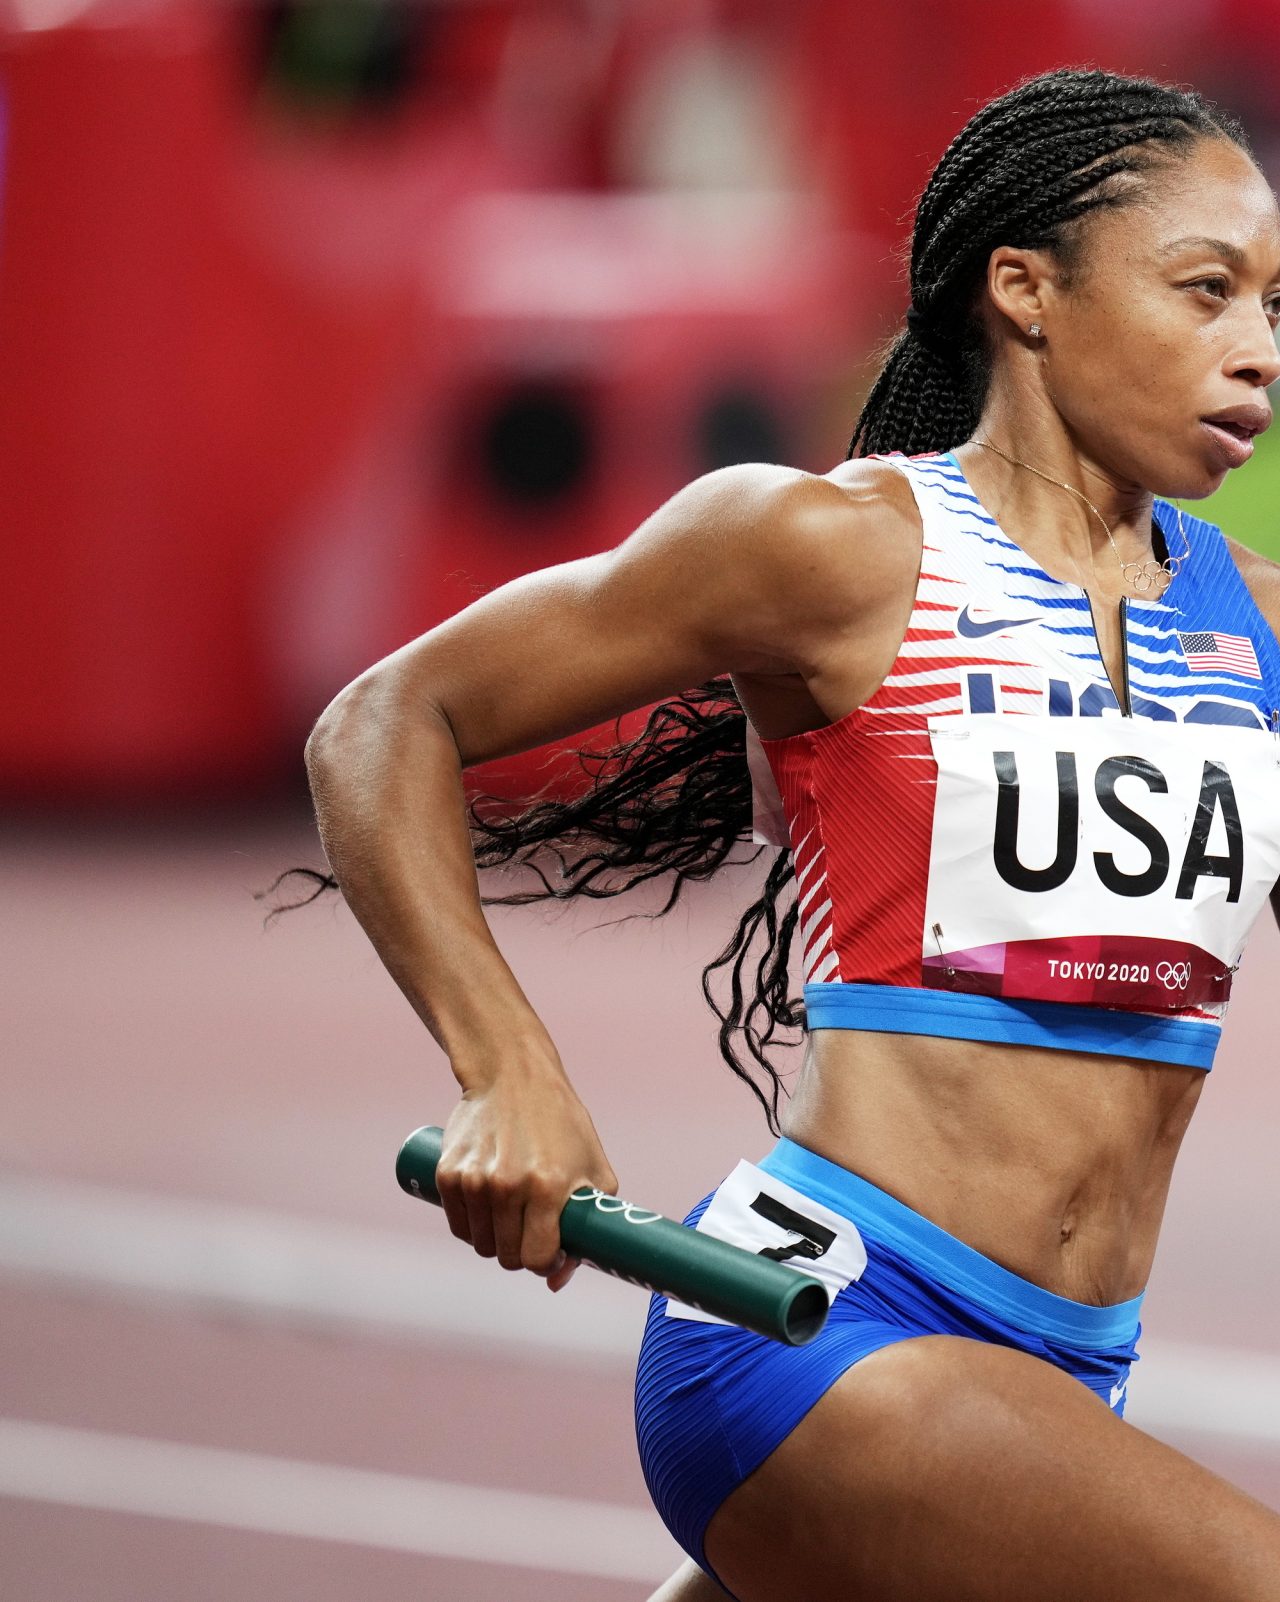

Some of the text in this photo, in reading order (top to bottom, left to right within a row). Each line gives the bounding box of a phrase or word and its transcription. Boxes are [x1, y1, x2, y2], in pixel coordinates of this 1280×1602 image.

[992, 750, 1245, 904] USA
[1047, 959, 1150, 983] TOKYO 2020
[749, 1191, 838, 1262] 7
